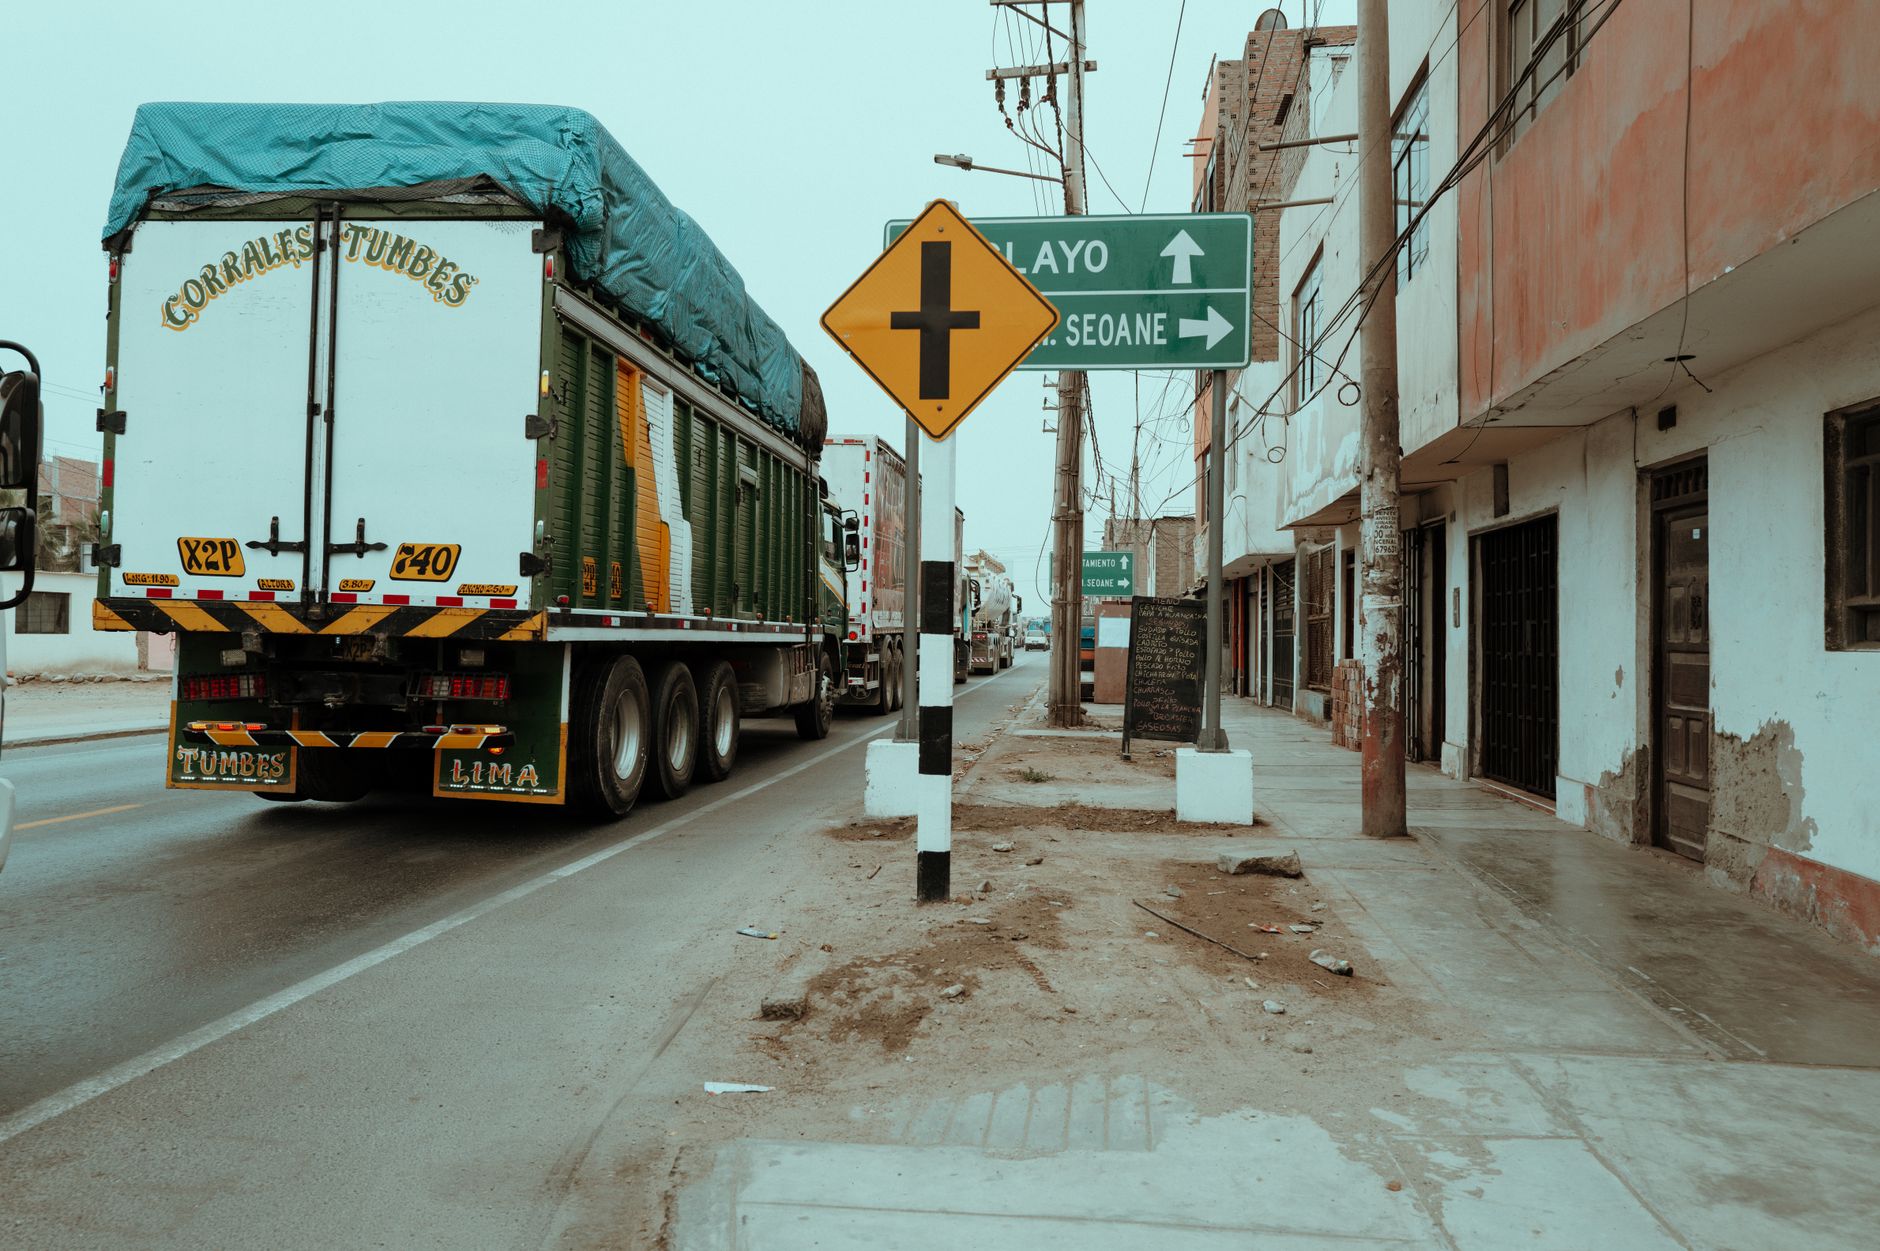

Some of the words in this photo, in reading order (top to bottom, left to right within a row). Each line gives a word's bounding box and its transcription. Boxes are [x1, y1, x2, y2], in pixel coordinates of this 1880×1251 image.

[990, 240, 1108, 274] LAYO
[162, 224, 314, 331] CORRALES
[341, 222, 479, 307] TUMBES
[1066, 312, 1167, 347] SEOANE
[183, 539, 236, 572] X2P
[395, 544, 452, 576] 740
[261, 579, 293, 589] ALTURA
[342, 580, 363, 589] 3.80
[1086, 579, 1114, 588] SEOANE
[177, 744, 286, 778] TUMBES
[450, 758, 539, 787] LIMA
